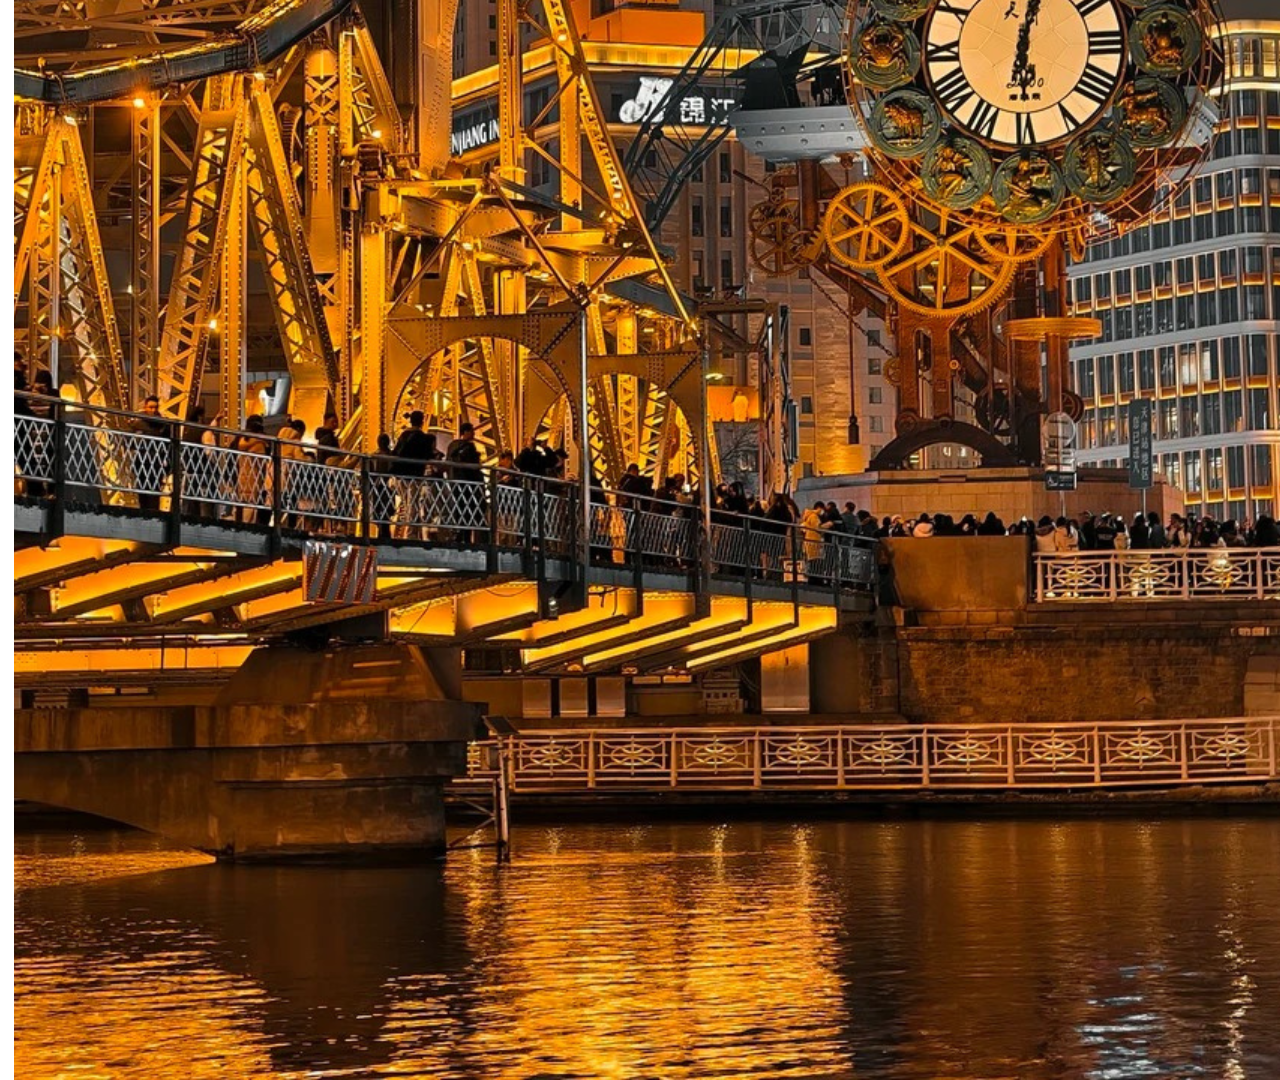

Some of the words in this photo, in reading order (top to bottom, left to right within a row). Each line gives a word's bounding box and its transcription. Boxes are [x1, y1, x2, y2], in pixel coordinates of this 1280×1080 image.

[1089, 31, 1121, 54] III
[680, 97, 735, 124] 锦江
[1058, 102, 1081, 131] V
